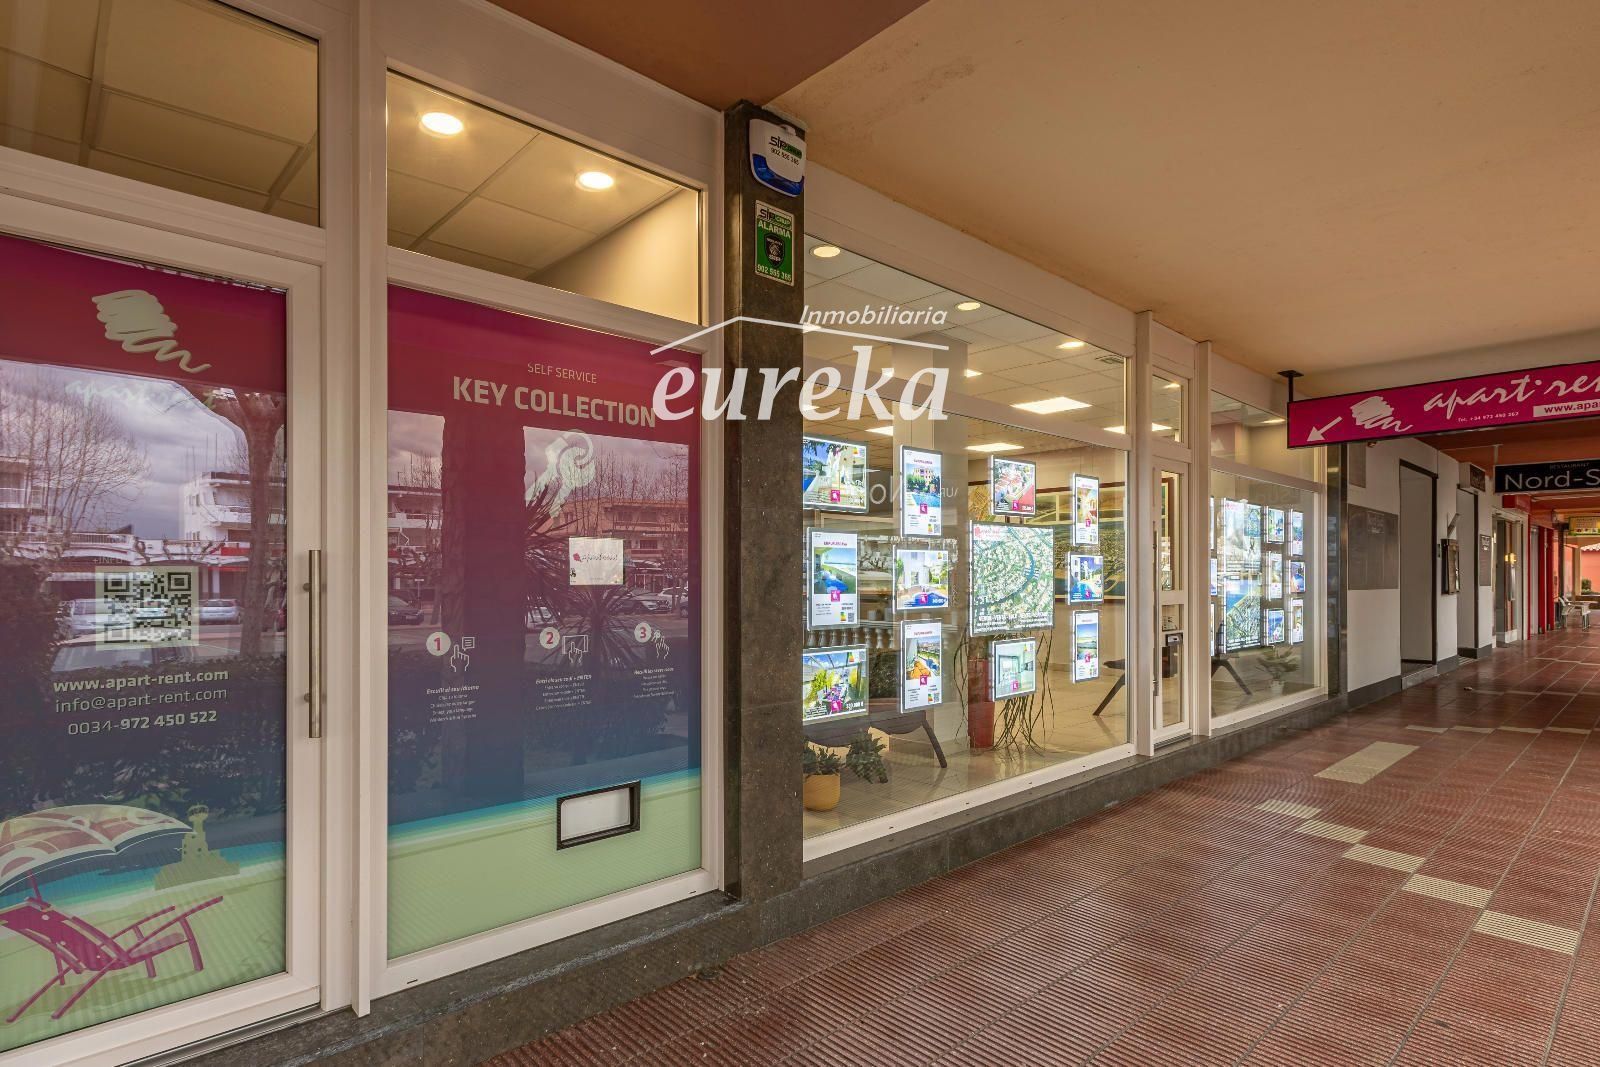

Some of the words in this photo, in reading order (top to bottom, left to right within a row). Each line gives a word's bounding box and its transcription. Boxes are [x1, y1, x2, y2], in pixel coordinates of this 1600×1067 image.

[758, 220, 791, 239] ALARMA
[757, 263, 769, 274] 902
[527, 362, 553, 376] SELF
[555, 366, 598, 384] SERVICE
[453, 376, 508, 406] KEY
[514, 386, 656, 428] COLLECTION
[1544, 401, 1600, 414] www.apa
[545, 631, 554, 645] 2
[639, 624, 647, 638] 3
[433, 637, 442, 651] 1
[53, 669, 229, 692] www.apart-rent.com
[55, 688, 228, 713] info@apart-rent.com
[68, 716, 150, 735] 0034-972
[154, 713, 186, 728] 450
[189, 710, 217, 724] 522
